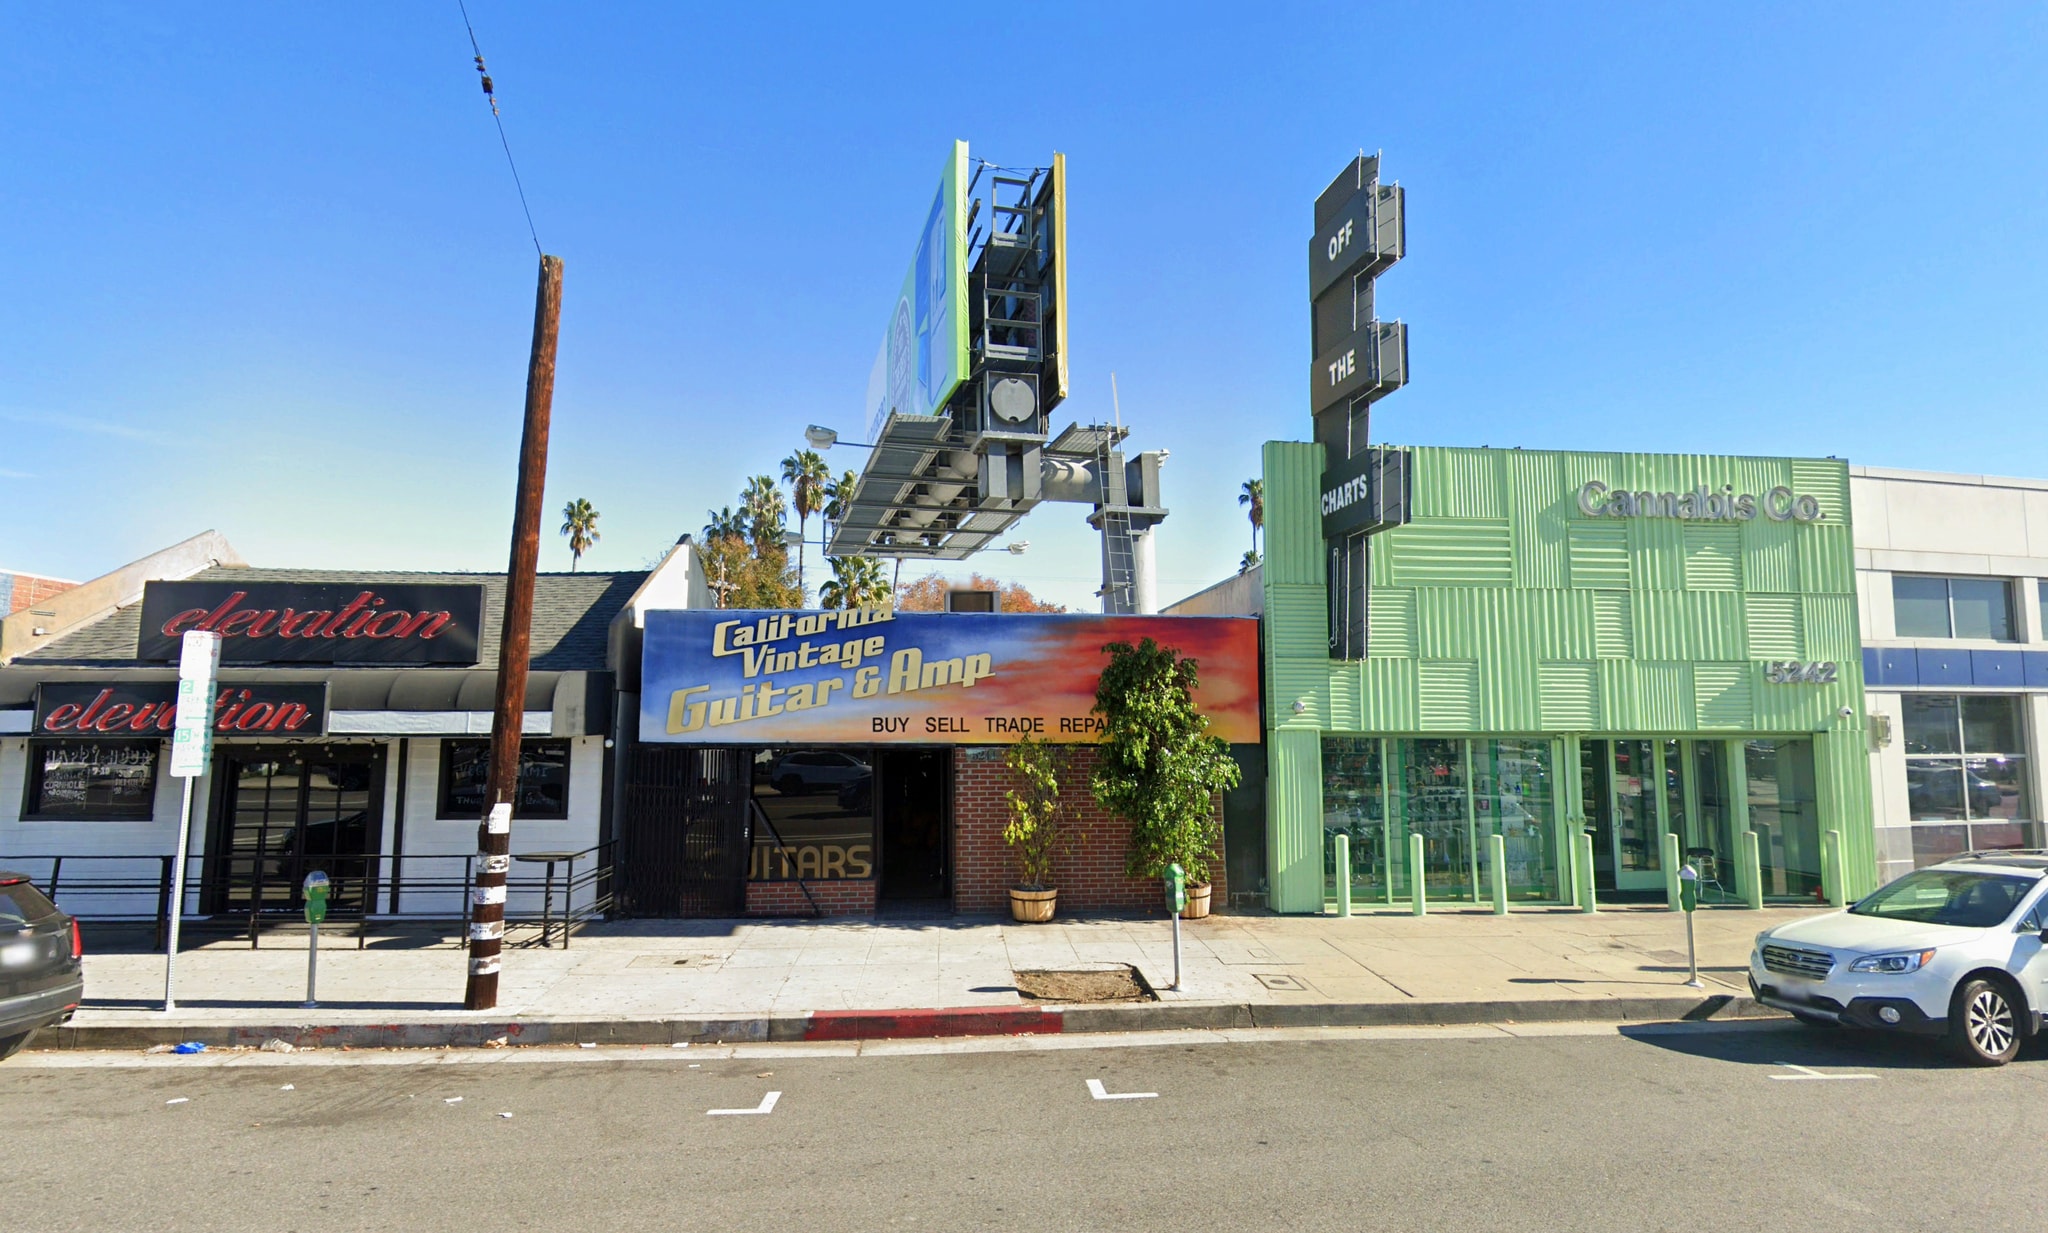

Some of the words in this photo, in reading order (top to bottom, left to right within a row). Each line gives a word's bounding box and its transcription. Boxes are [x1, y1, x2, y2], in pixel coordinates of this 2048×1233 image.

[1328, 218, 1353, 262] OFF
[1328, 348, 1356, 387] THE
[1321, 473, 1367, 517] CHARTS
[1577, 480, 1757, 521] Cannabis
[1763, 485, 1827, 522] Co.
[161, 591, 457, 639] elevation
[712, 602, 897, 657] California
[743, 636, 885, 678] Vintage
[1766, 660, 1838, 684] 5242
[666, 677, 844, 734] Guitar
[852, 666, 882, 698] &
[887, 647, 996, 695] Amp
[177, 731, 190, 742] 15
[872, 717, 910, 733] BUY
[925, 717, 970, 733] SELL
[984, 717, 1044, 733] TRADE
[749, 845, 873, 880] ITARS
